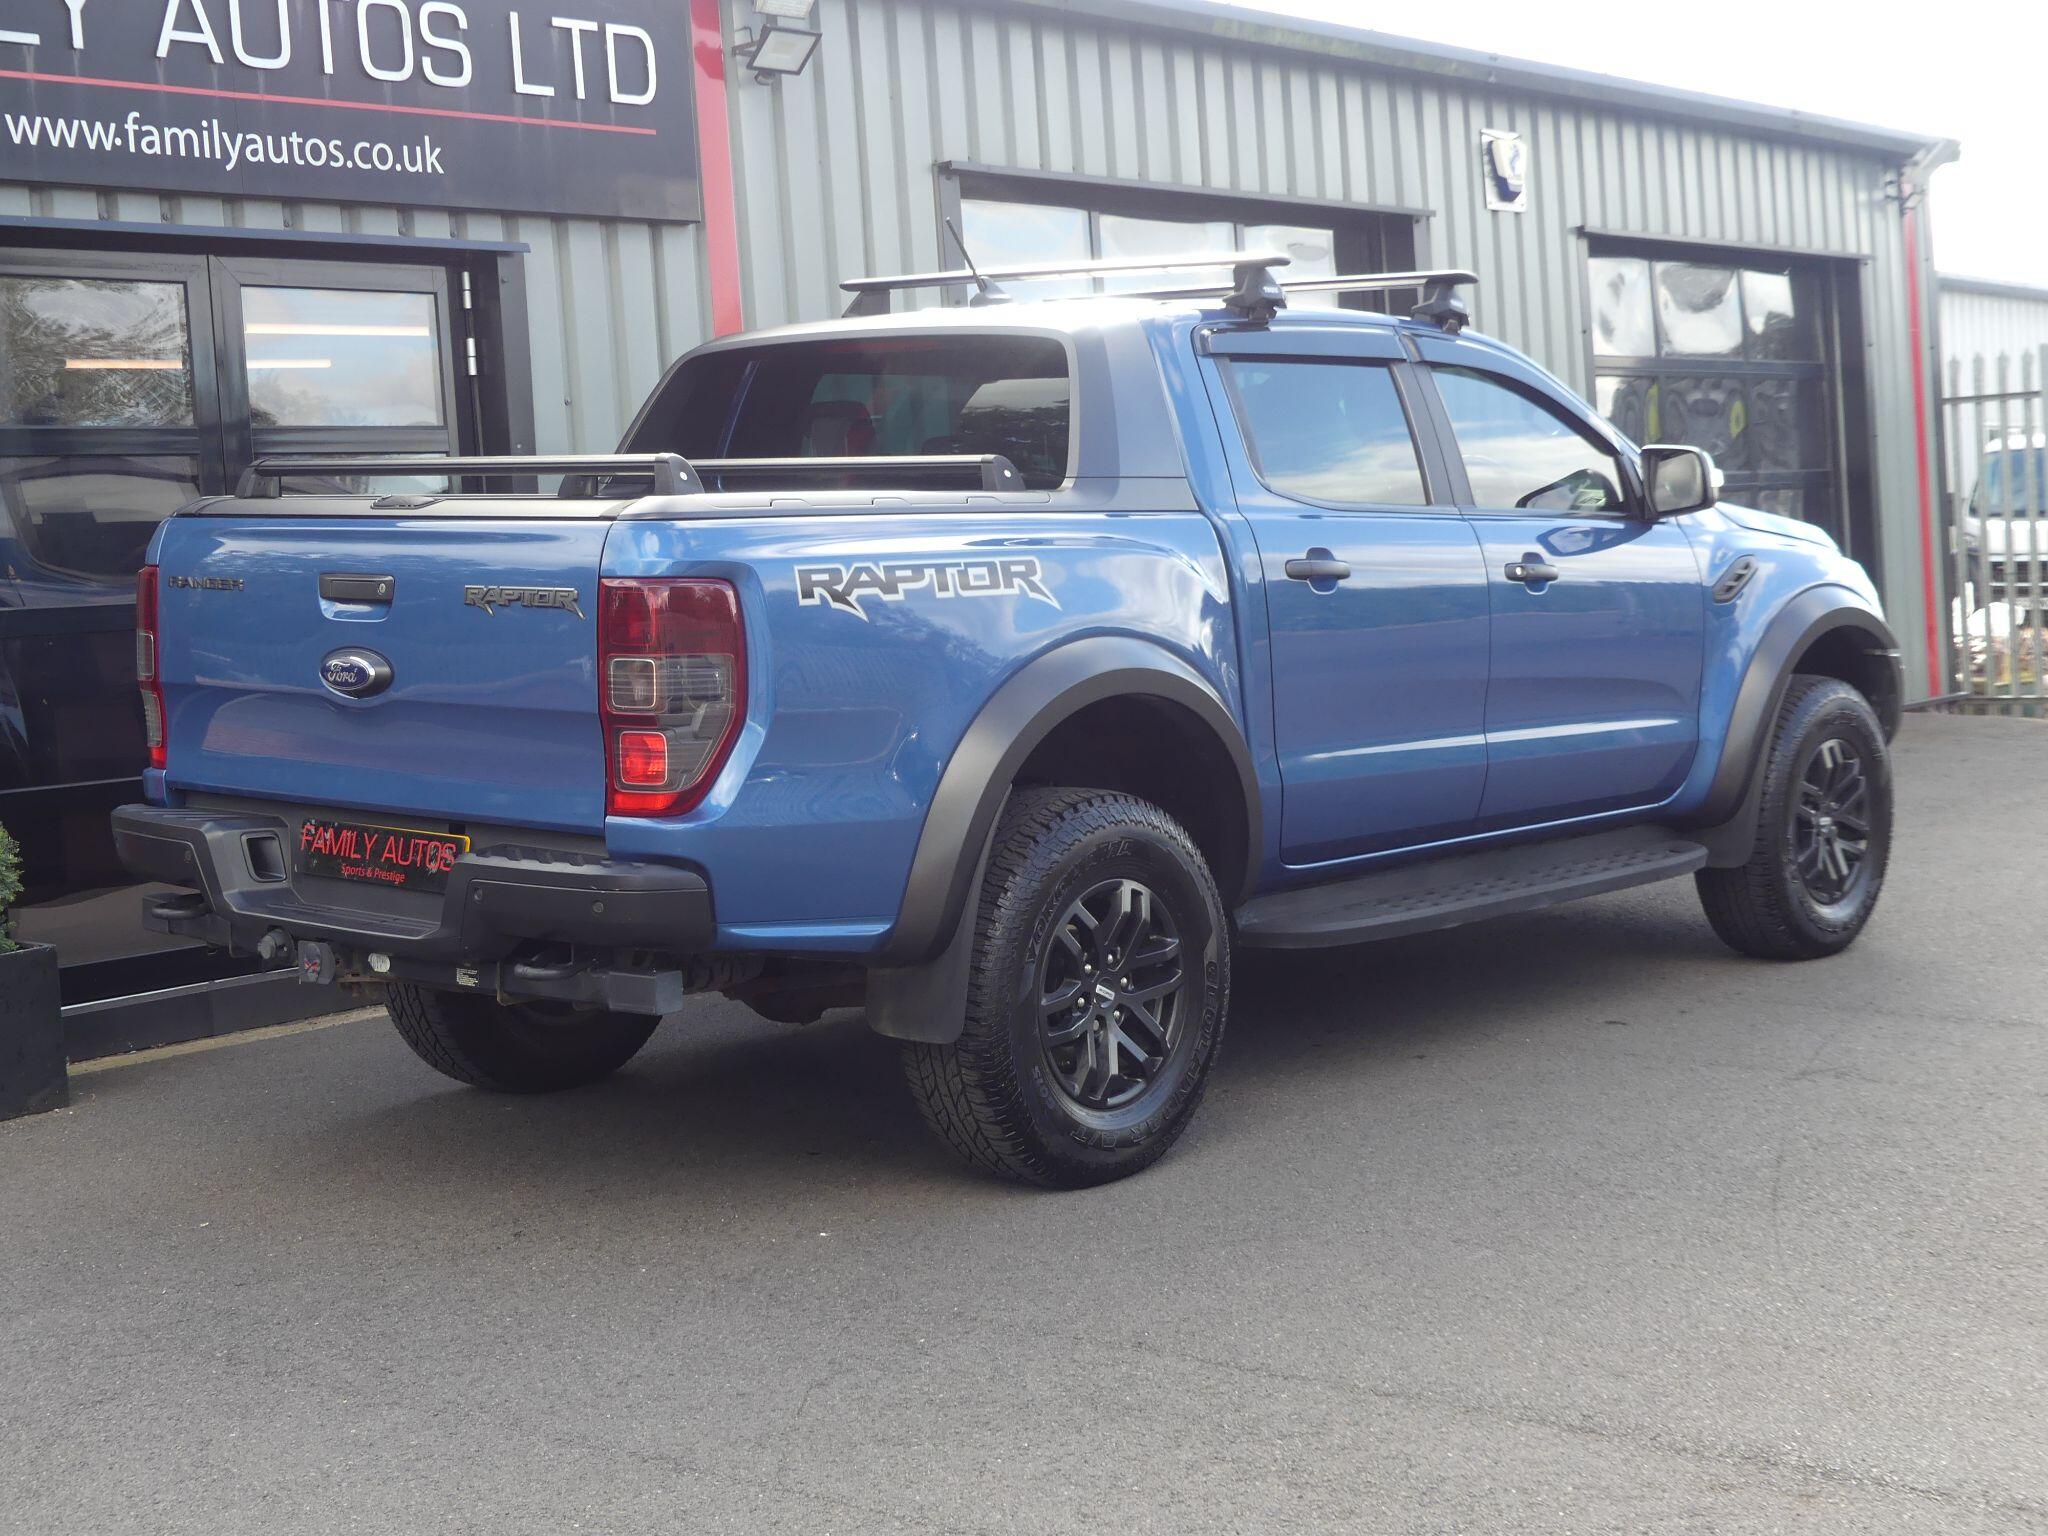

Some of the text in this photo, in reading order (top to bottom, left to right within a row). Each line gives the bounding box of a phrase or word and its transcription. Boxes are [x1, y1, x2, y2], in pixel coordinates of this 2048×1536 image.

[156, 0, 472, 88] AUTOS
[510, 11, 656, 105] LTD
[4, 111, 444, 174] www.familyautos.co.uk
[464, 585, 586, 620] RAPTOR
[794, 556, 1062, 623] RAPTOR
[326, 659, 358, 683] Ford
[300, 822, 457, 872] FAMILY AUTOS
[341, 864, 406, 885] Sports & Prestige
